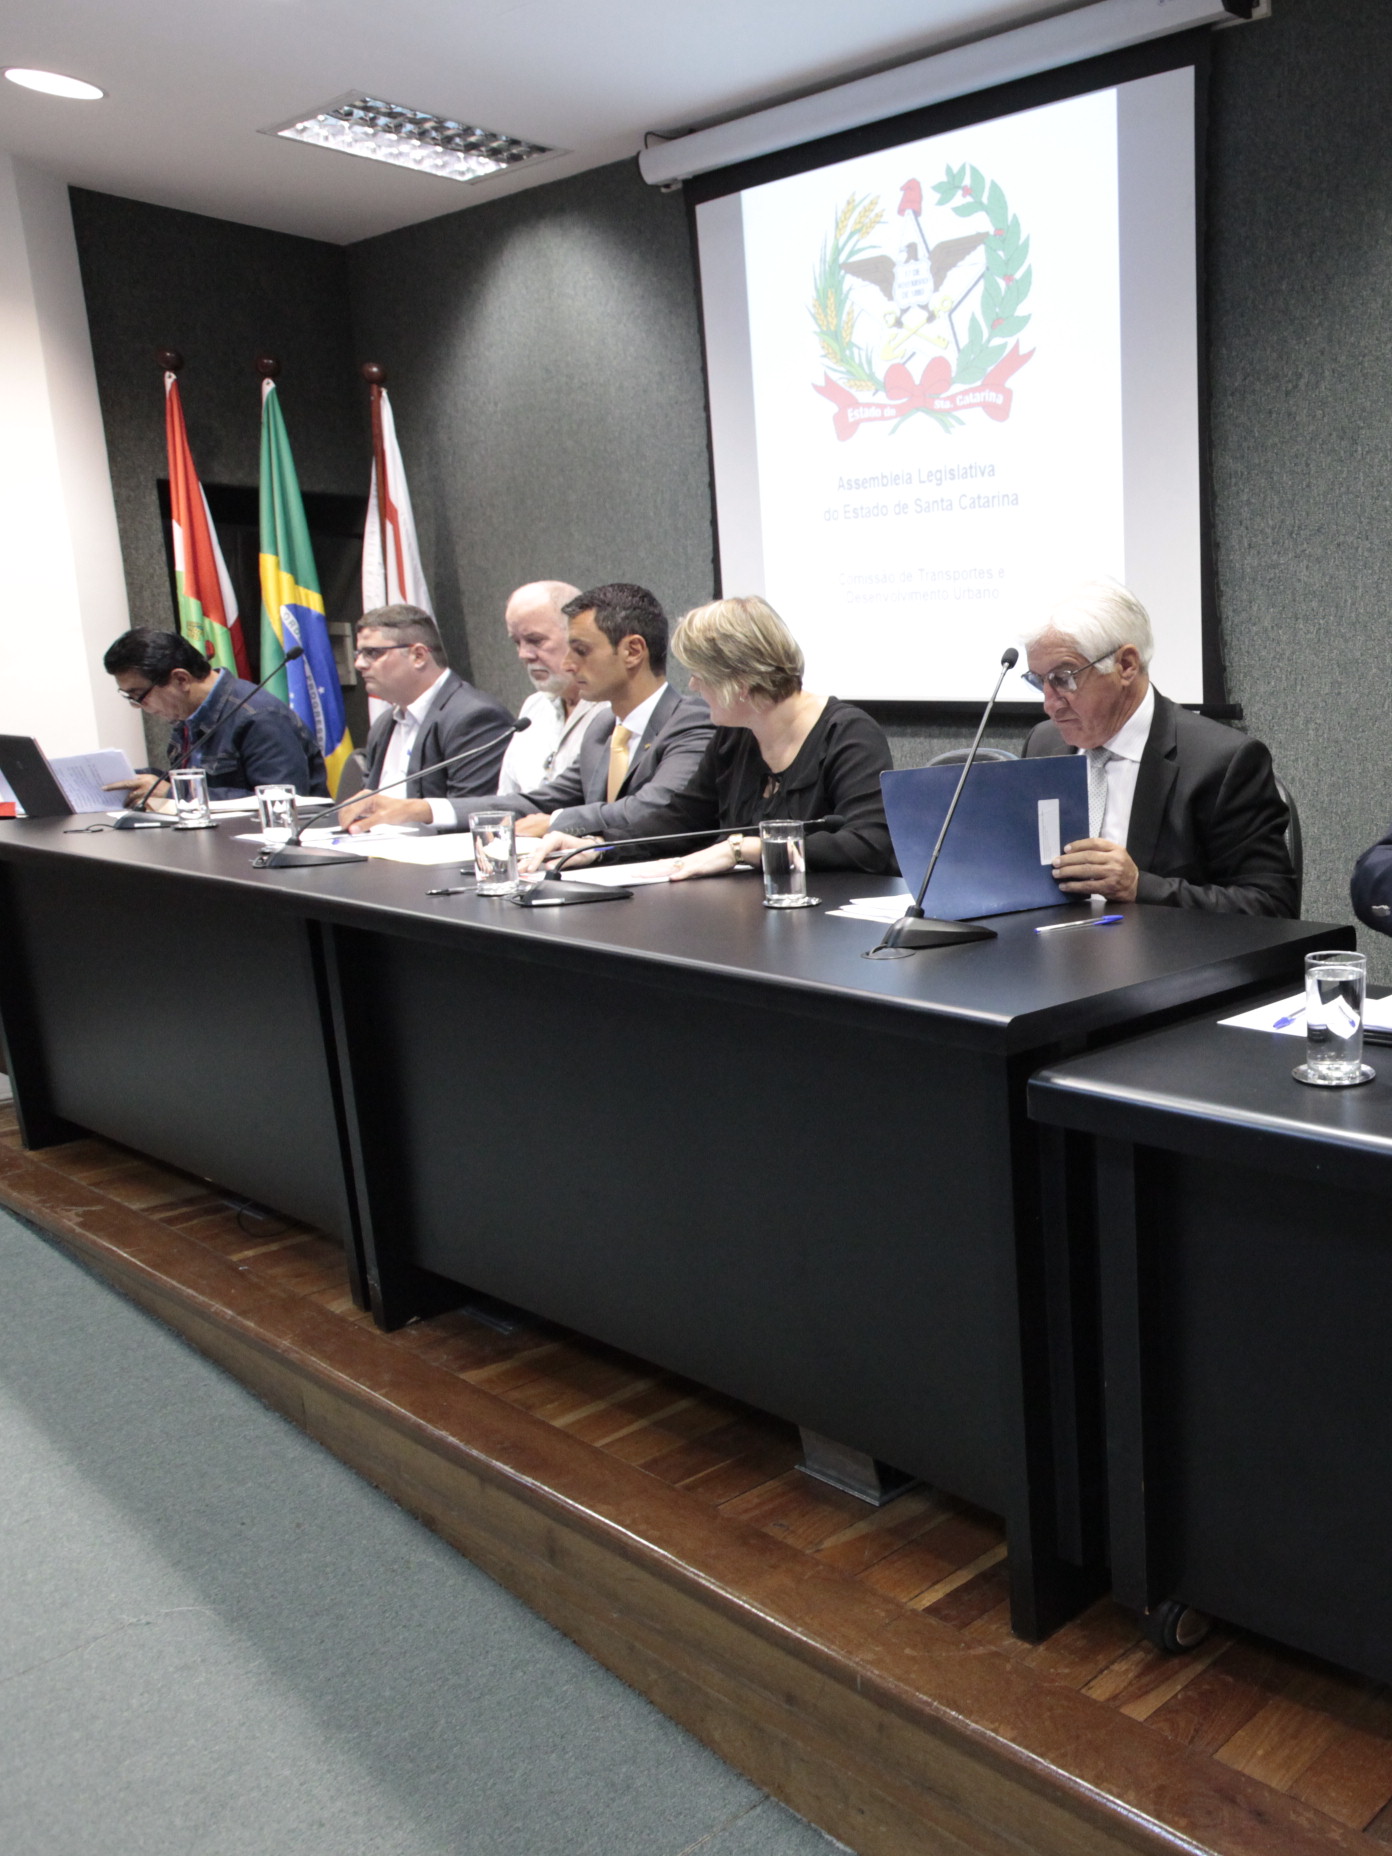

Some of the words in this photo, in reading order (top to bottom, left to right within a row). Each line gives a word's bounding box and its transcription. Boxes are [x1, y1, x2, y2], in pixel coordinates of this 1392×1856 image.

[956, 389, 1004, 407] Catarina
[847, 407, 881, 422] Estado
[918, 461, 996, 487] Legislativa
[824, 507, 839, 521] do
[843, 502, 889, 520] Estado
[893, 499, 909, 516] de
[914, 496, 953, 514] Santa
[958, 490, 1020, 511] Catarina
[899, 570, 913, 583] de
[917, 566, 994, 584] Transportes
[998, 567, 1005, 579] e
[846, 588, 949, 604] Desenvolvimento
[953, 585, 1000, 601] Urbano
